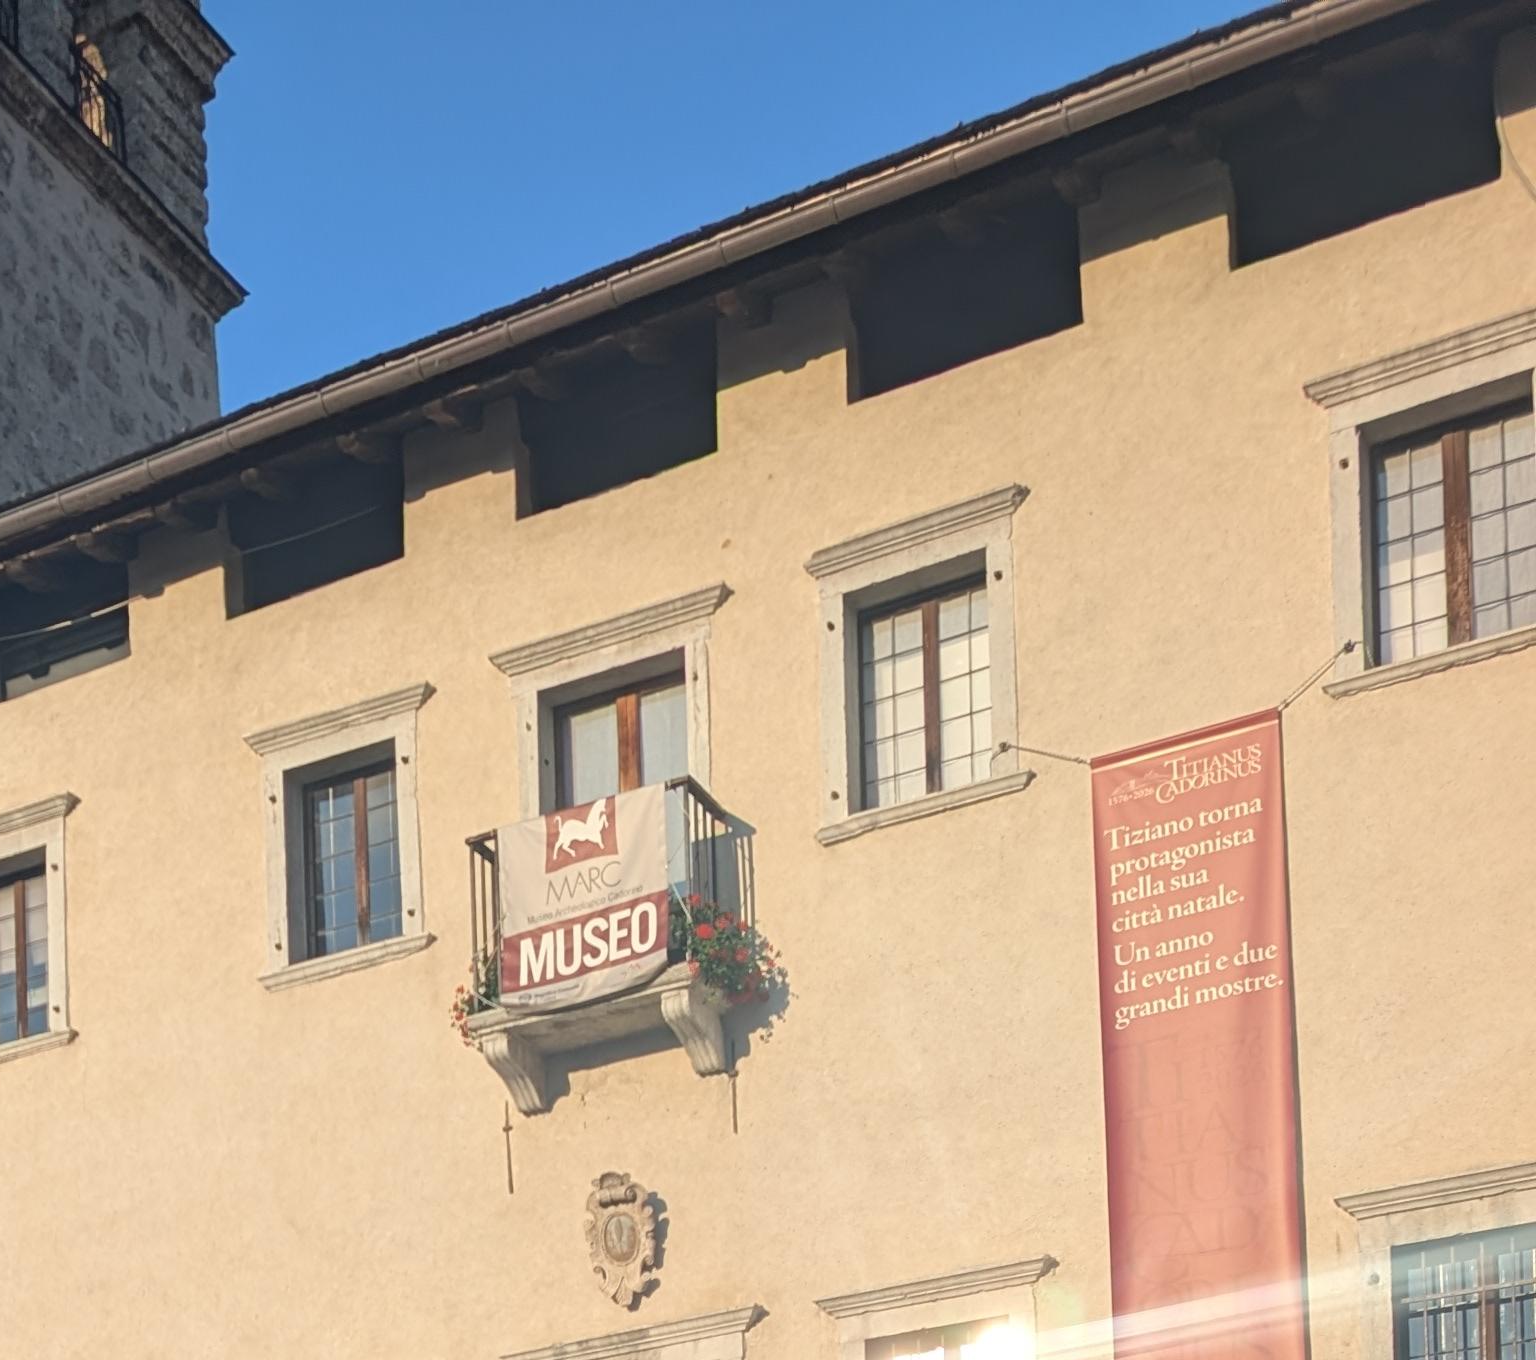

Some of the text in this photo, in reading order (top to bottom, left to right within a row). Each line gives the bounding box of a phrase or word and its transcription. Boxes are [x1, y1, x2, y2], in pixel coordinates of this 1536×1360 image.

[1155, 760, 1262, 804] CADORINUS
[1164, 743, 1262, 781] TITIANUS
[1104, 798, 1263, 851] Tiziano torna
[545, 860, 623, 905] MARC
[1110, 828, 1256, 887] protagonista
[1111, 868, 1210, 906] nella sua
[1111, 883, 1245, 933] città natale.
[518, 901, 658, 988] MUSEO
[1114, 931, 1214, 966] Un anno
[1114, 941, 1278, 994] di eventi e due
[1114, 973, 1284, 1030] grandi mostre.
